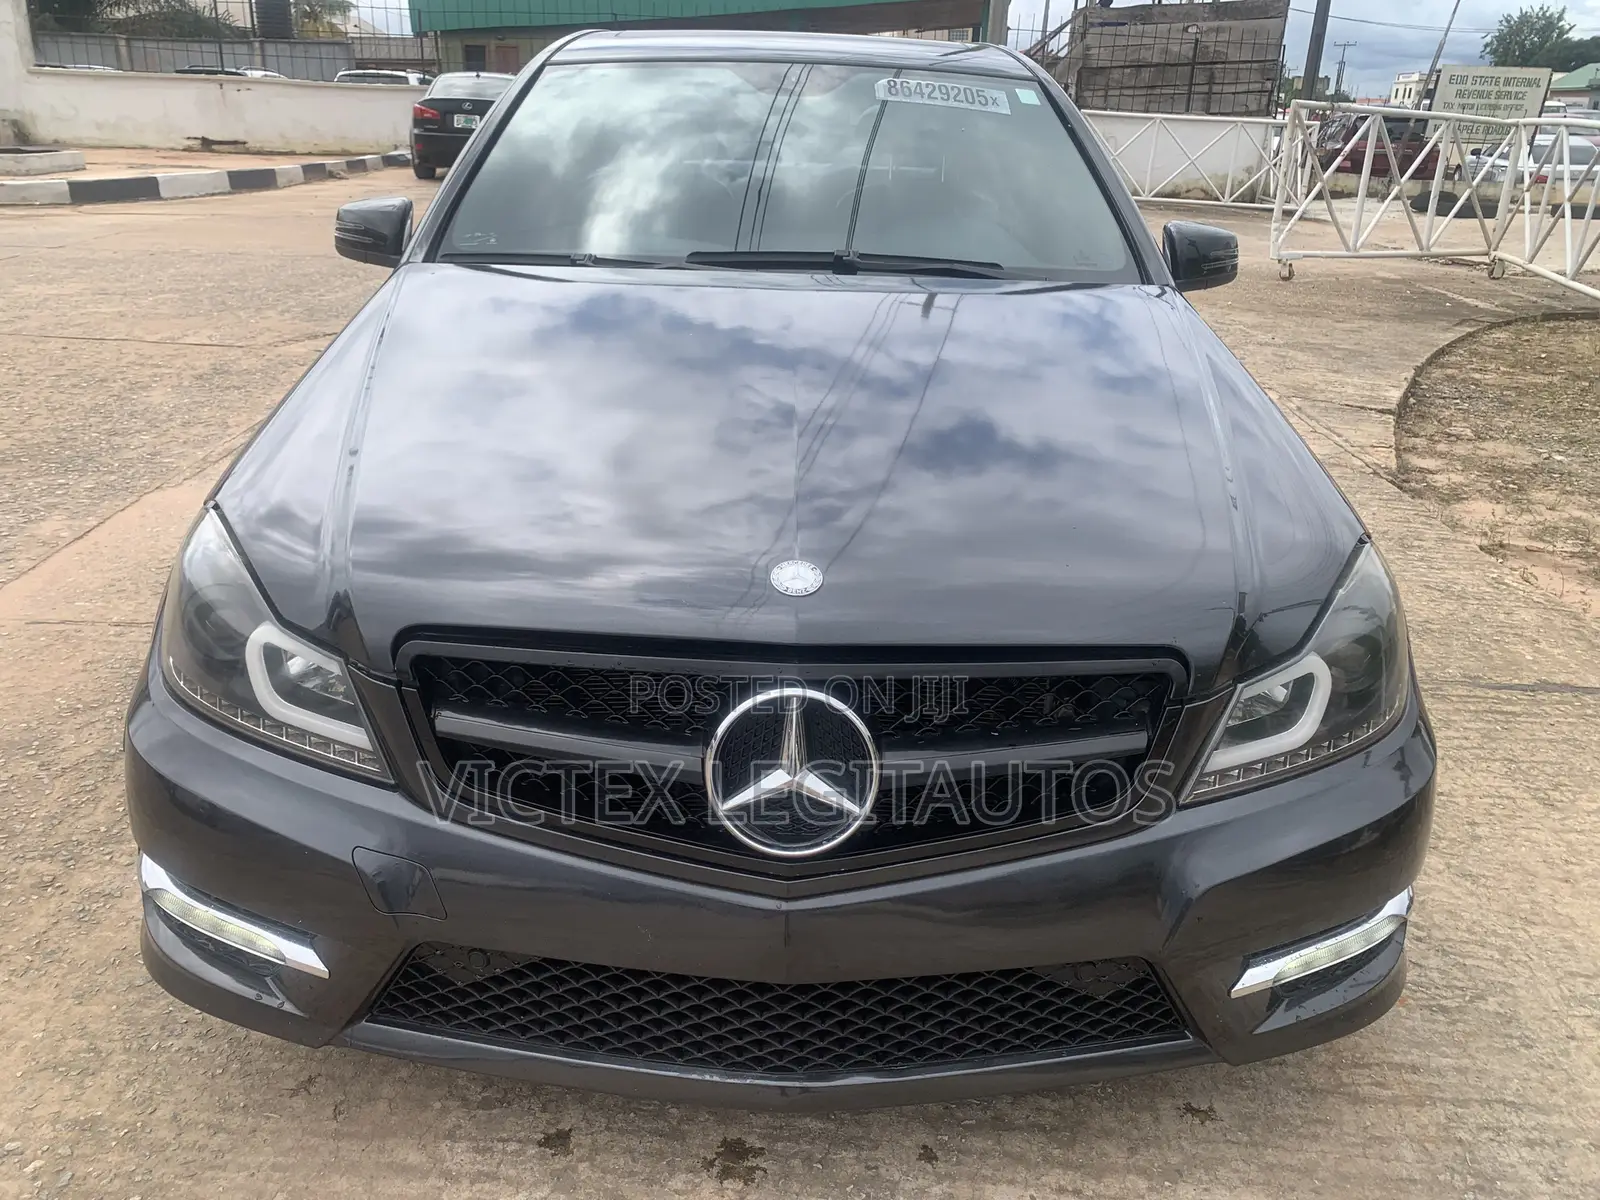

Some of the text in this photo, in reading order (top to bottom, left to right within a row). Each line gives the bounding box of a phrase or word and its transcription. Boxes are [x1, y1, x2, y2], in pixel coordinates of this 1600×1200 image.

[1448, 74, 1542, 88] EDO STATE INTERNAL
[1454, 89, 1528, 101] REVENUE SERVICE
